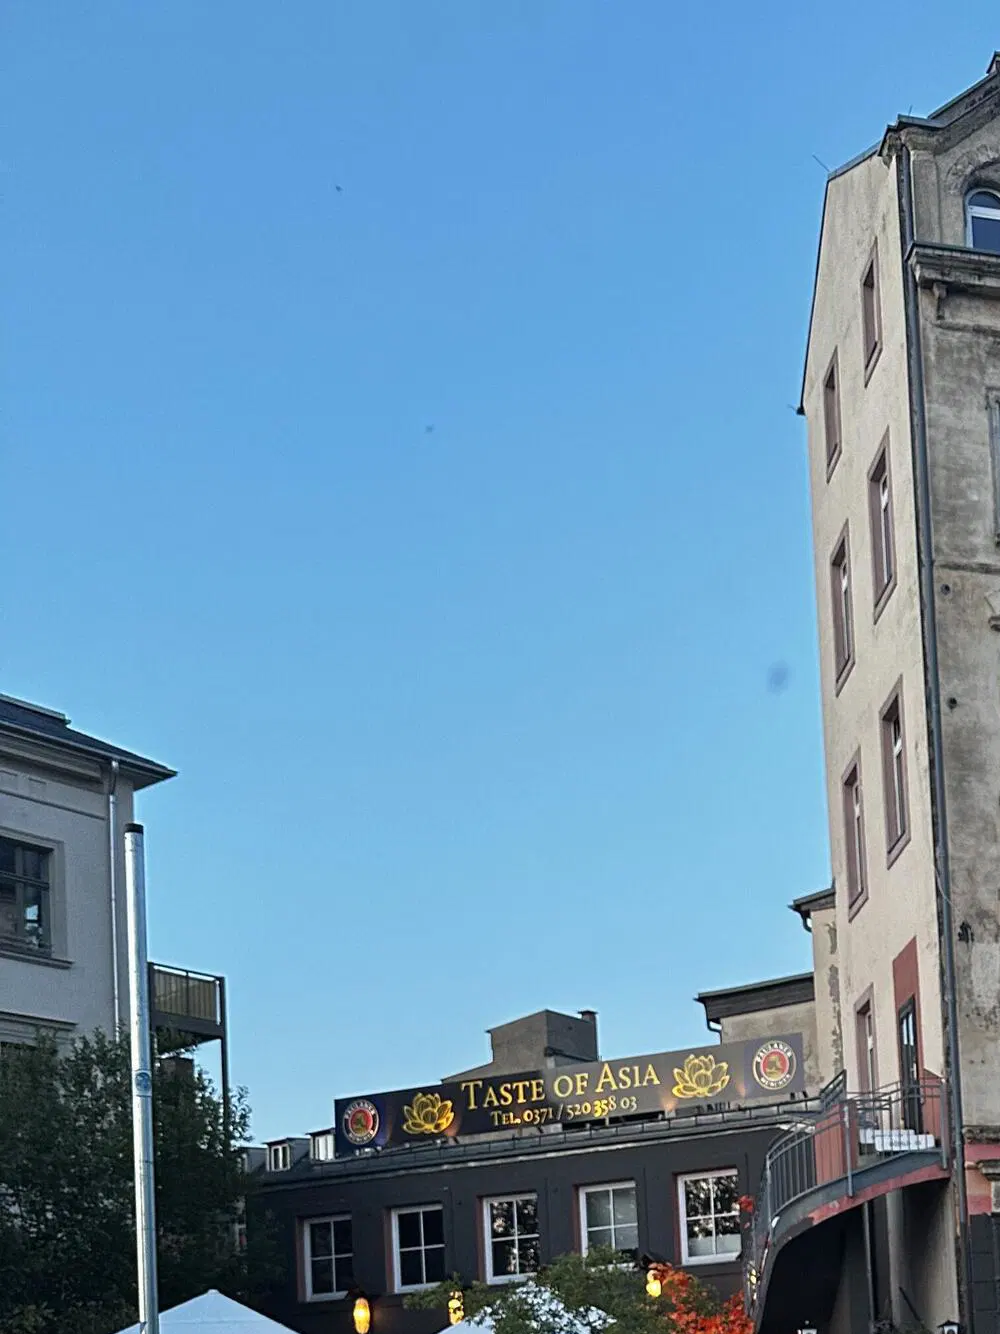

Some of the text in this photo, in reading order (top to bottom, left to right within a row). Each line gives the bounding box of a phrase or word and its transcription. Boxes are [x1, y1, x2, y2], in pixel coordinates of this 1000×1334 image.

[461, 1062, 661, 1110] TASTE OF ASIA
[523, 1106, 553, 1125] 0371
[566, 1101, 591, 1120] 520
[594, 1095, 617, 1118] 358
[621, 1096, 638, 1112] 03
